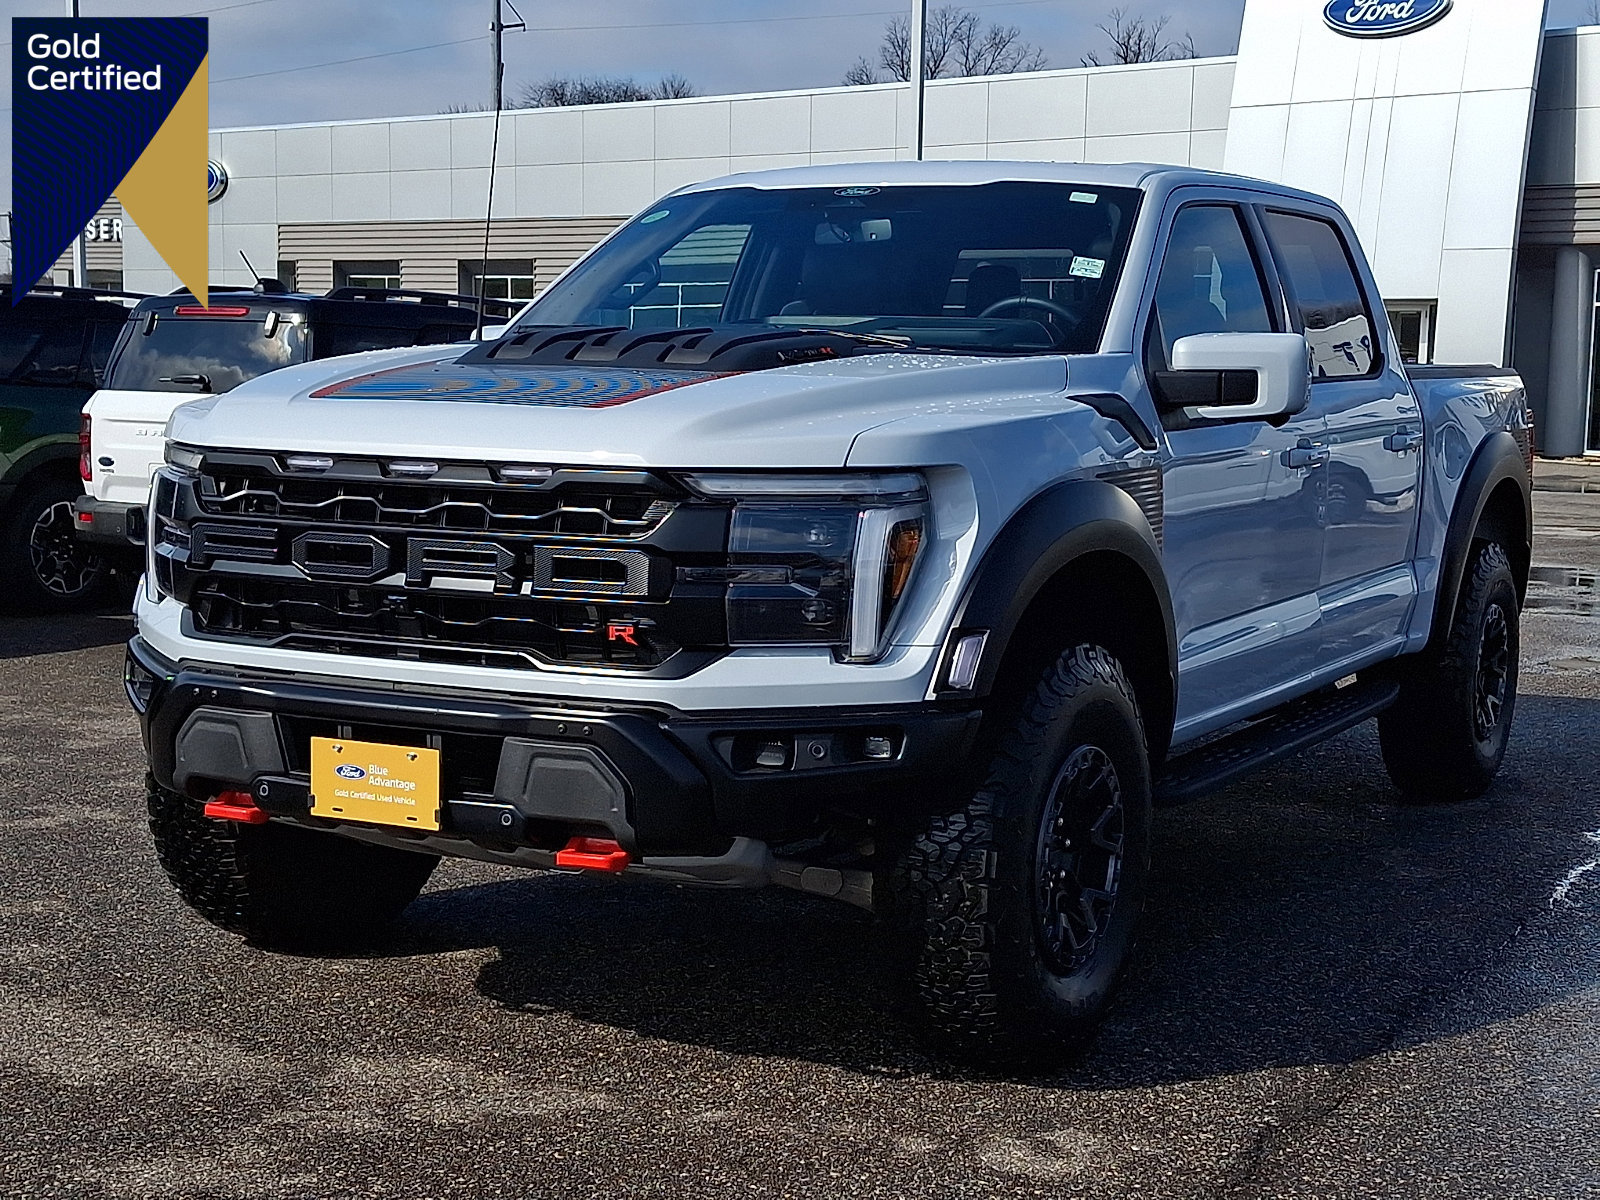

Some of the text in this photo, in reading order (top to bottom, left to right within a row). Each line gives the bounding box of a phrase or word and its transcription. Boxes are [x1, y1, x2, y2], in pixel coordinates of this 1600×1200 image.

[190, 521, 651, 597] FORD
[340, 765, 361, 778] Ford
[368, 764, 389, 776] Blue
[368, 775, 416, 791] Advantage
[334, 788, 416, 806] Gold Certified Used Vehicle
